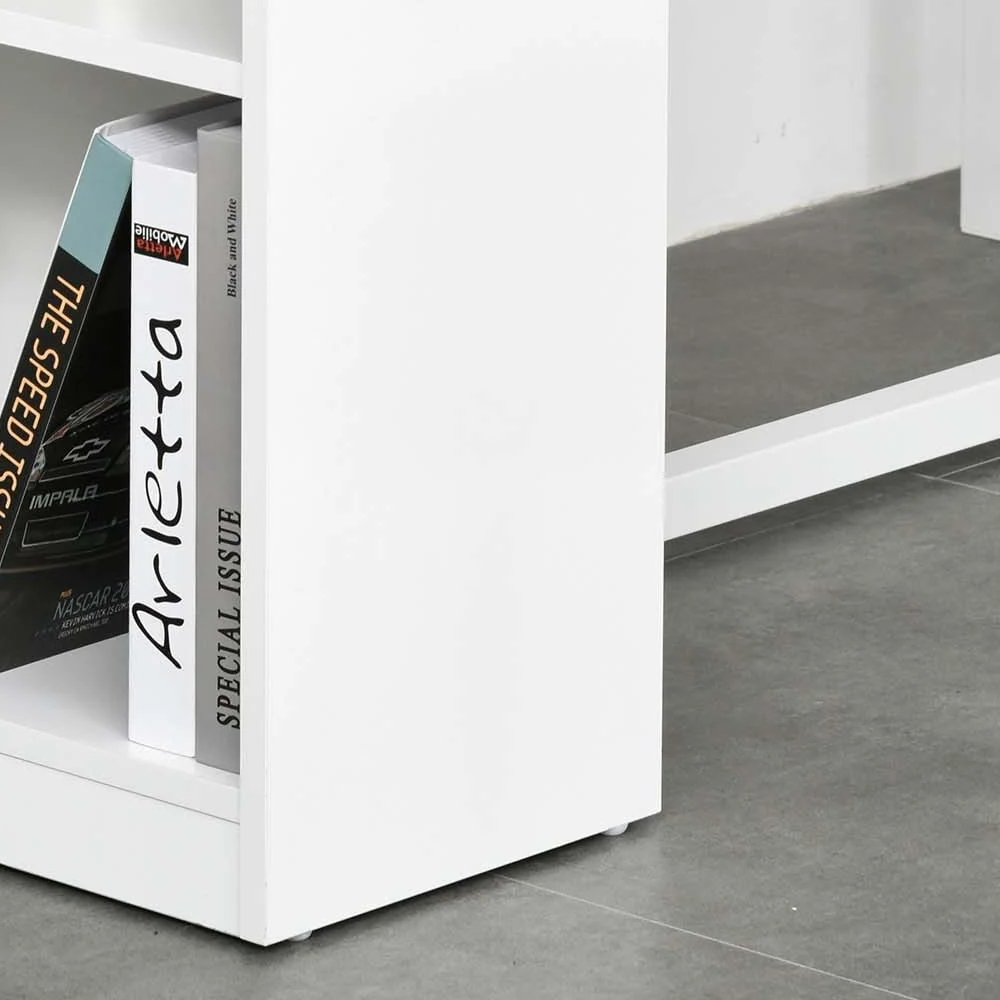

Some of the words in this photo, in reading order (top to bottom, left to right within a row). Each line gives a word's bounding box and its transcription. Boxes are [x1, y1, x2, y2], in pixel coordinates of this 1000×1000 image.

[227, 198, 237, 234] White
[135, 225, 187, 250] Mobilie
[227, 237, 237, 261] and
[227, 263, 237, 298] Black
[40, 275, 85, 345] THE
[7, 338, 60, 446] SPEED
[29, 484, 98, 510] IMPALA
[132, 318, 184, 669] Arletta
[217, 508, 241, 596] ISSUE
[52, 586, 112, 620] NASCAR
[217, 609, 240, 729] SPECIAL
